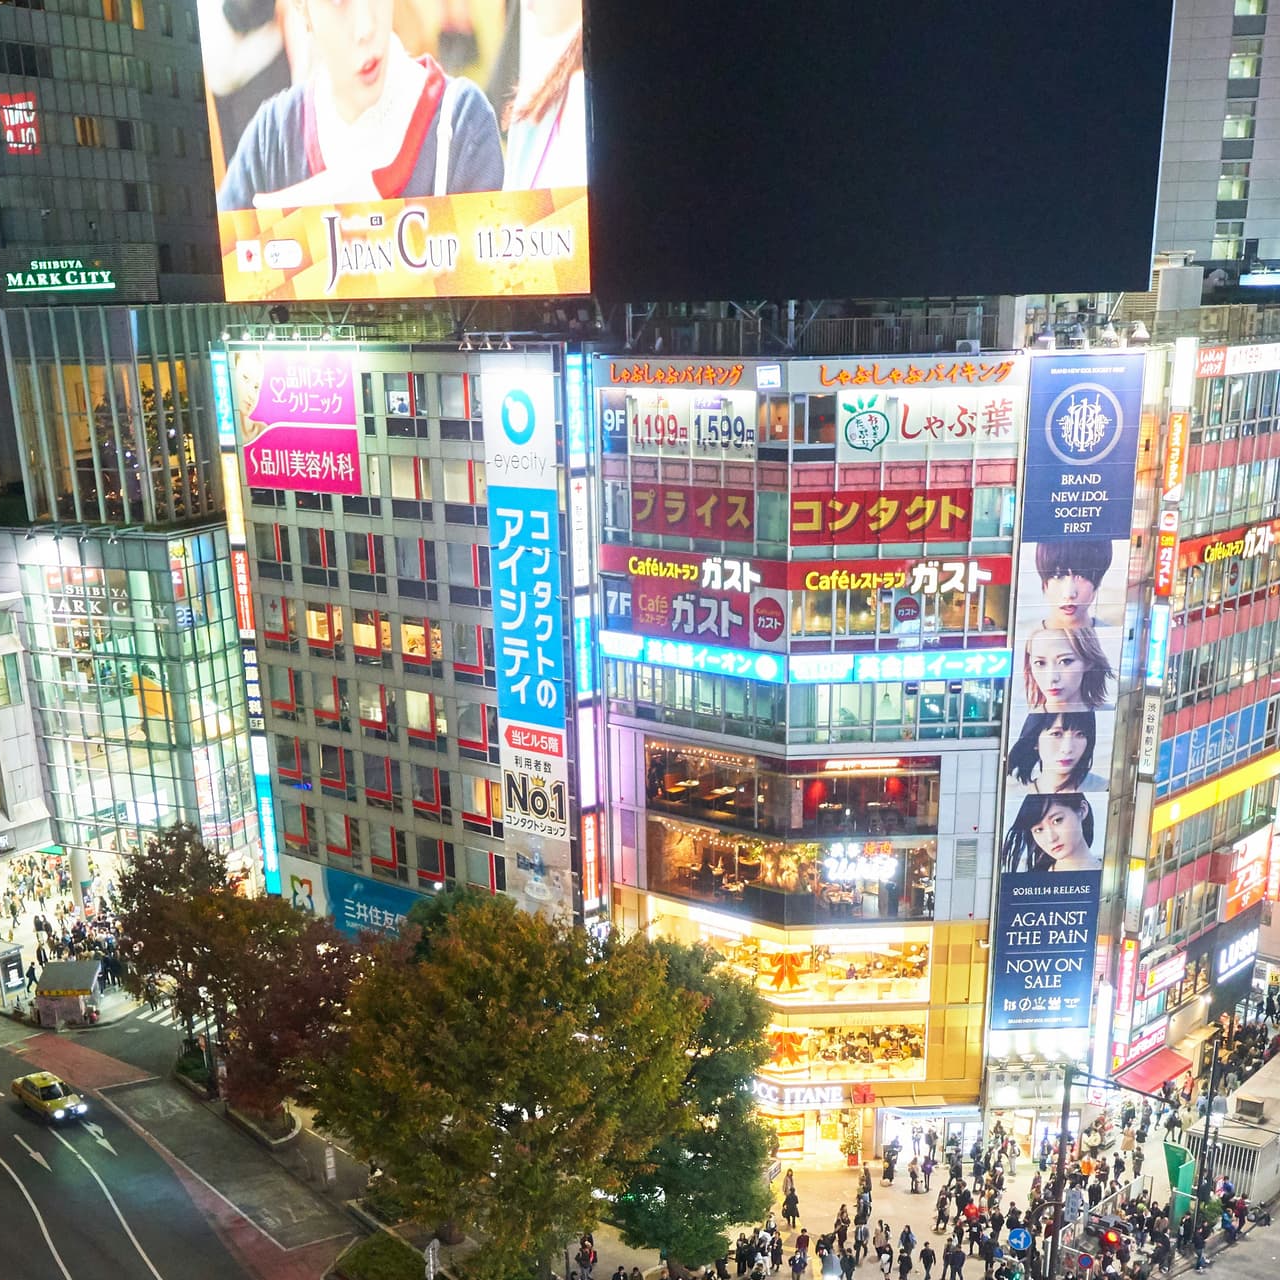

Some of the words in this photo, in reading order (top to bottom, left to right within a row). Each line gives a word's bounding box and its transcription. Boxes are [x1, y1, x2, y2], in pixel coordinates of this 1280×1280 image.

[397, 211, 458, 269] CUP
[476, 228, 527, 260] 11.25
[530, 229, 572, 256] SUN
[30, 260, 83, 271] SHIBUYA
[6, 272, 61, 287] MARK
[65, 270, 112, 285] CITY
[286, 367, 348, 389] 品川スキン
[610, 362, 744, 387] しゃぶしゃぶバイキング
[820, 361, 1015, 388] しゃぶしゃぶバイキング
[289, 392, 343, 414] クリニック
[603, 409, 626, 432] 9F
[901, 397, 1014, 440] しゃぶ葉
[260, 449, 355, 481] 品川美容外科
[494, 452, 547, 477] eyecity
[1061, 473, 1102, 486] BRAND
[1051, 491, 1078, 503] NEW
[632, 488, 752, 531] プライス
[792, 494, 966, 533] コンタクト
[628, 556, 699, 580] Caféレストラン
[701, 557, 762, 593] ガスト
[805, 570, 906, 591] Caféレストラン
[910, 560, 993, 595] ガスト
[496, 508, 531, 705] アイシティ
[530, 510, 557, 709] コンタクトの
[606, 590, 632, 615] 7F
[639, 594, 669, 614] Café
[671, 593, 743, 638] ガスト
[757, 616, 782, 630] ガスト
[512, 730, 559, 753] 当ビル5階
[1142, 702, 1157, 768] 渋谷駅前ビル
[514, 755, 552, 774] 利用者数
[504, 770, 567, 824] No.1
[505, 814, 567, 838] コンタクトショップ
[1053, 885, 1091, 895] RELEASE
[1007, 931, 1041, 946] THE
[1006, 958, 1052, 974] NOW
[1055, 957, 1083, 973] ON
[1024, 974, 1063, 990] SALE
